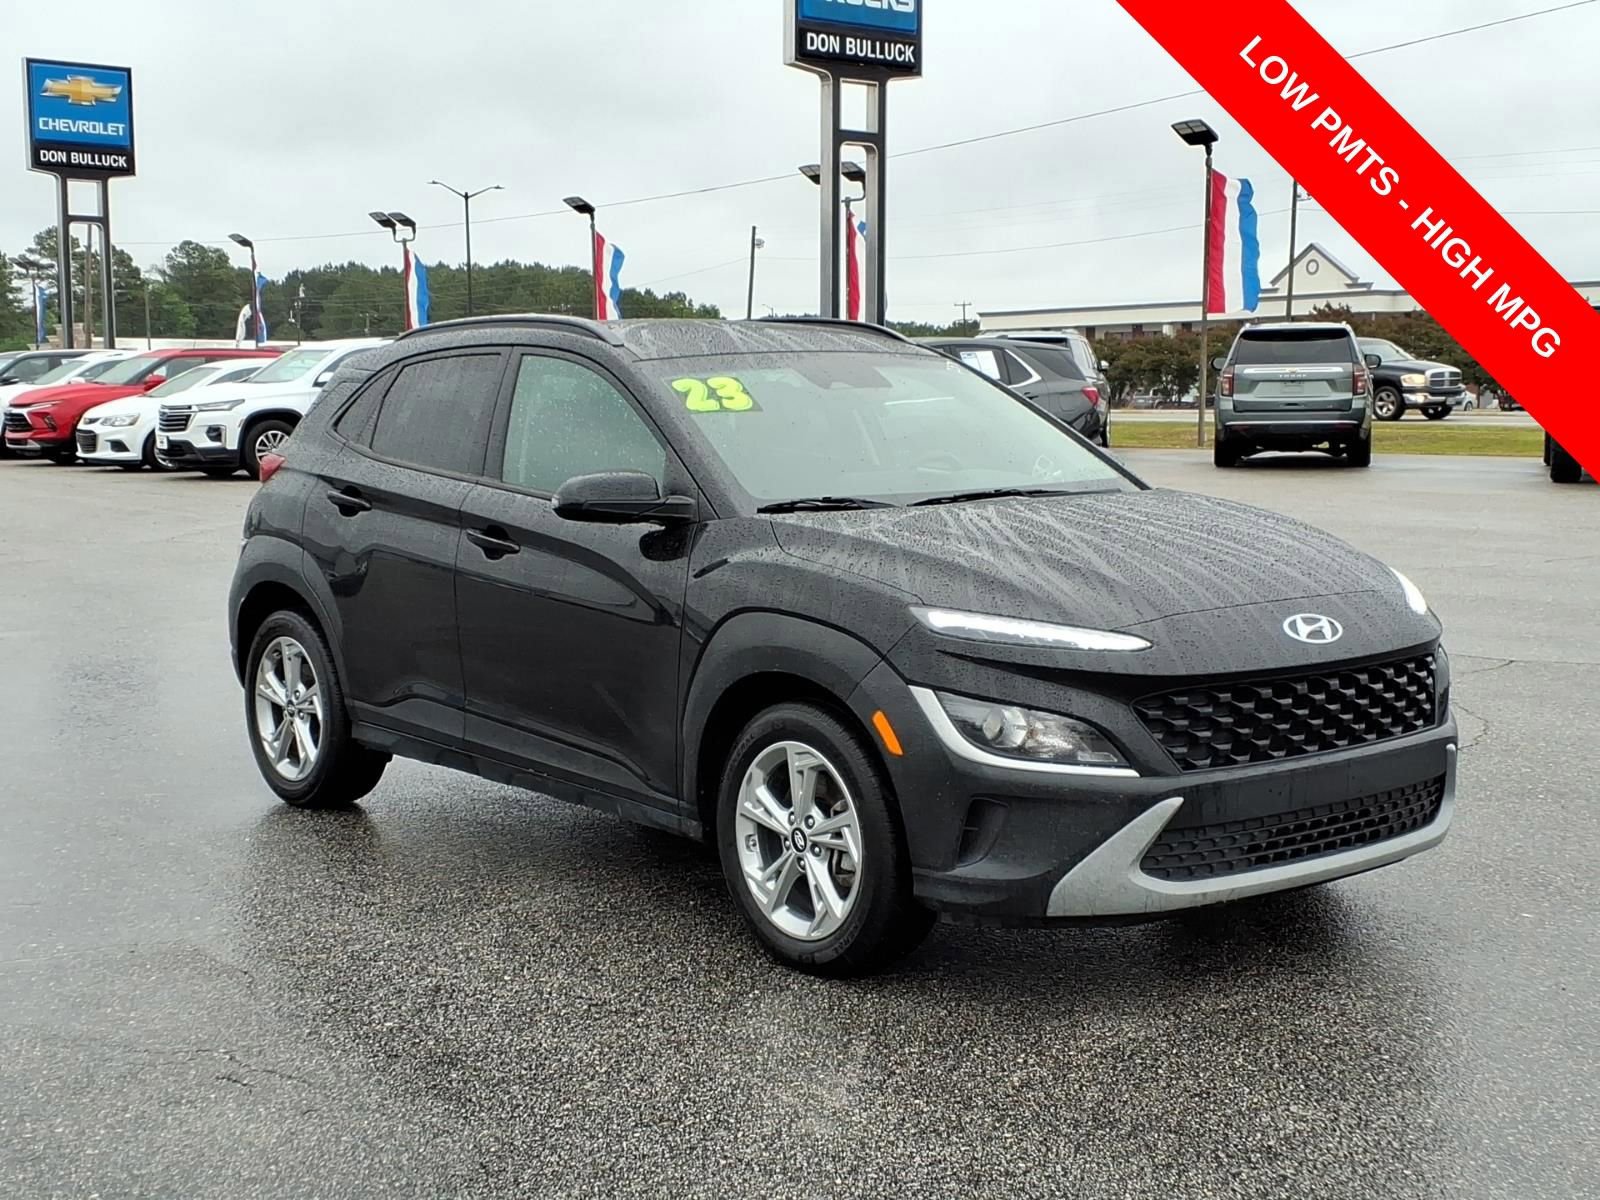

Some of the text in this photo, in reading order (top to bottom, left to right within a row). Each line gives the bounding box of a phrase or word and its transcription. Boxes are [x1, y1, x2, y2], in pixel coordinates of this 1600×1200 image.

[806, 32, 915, 63] DON BULLUCK
[38, 117, 126, 136] CHEVROLET
[39, 149, 127, 167] DON BULLUCK
[671, 376, 753, 411] 23
